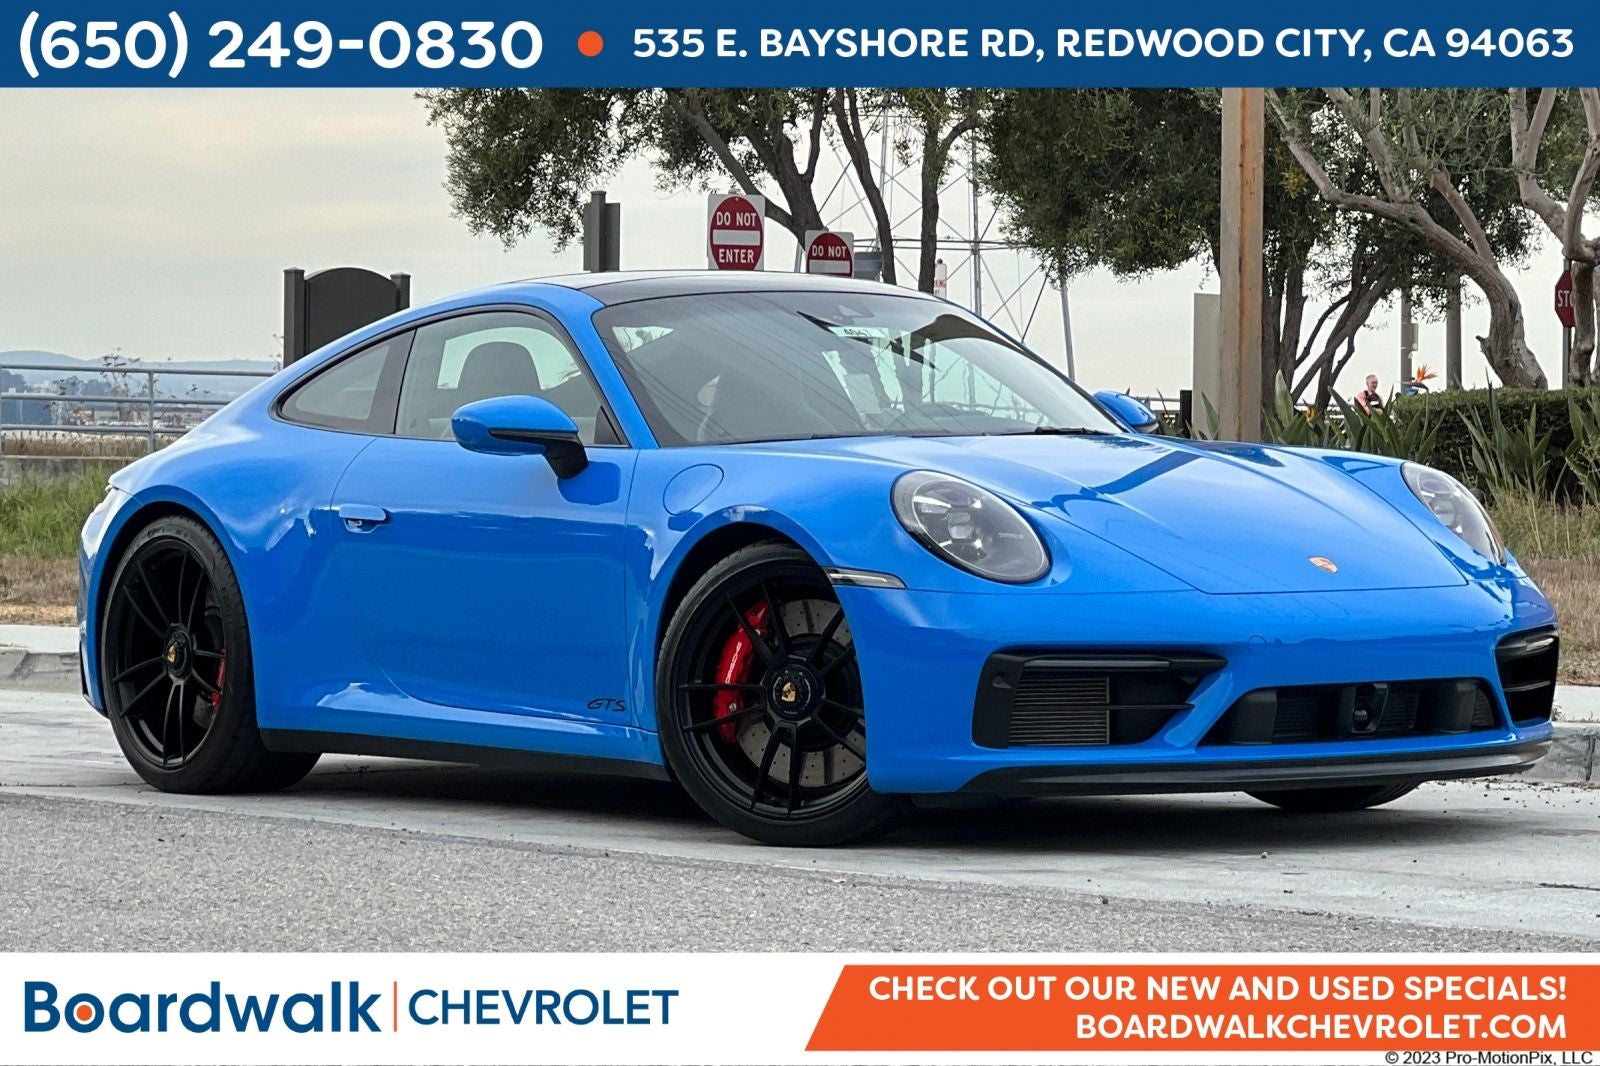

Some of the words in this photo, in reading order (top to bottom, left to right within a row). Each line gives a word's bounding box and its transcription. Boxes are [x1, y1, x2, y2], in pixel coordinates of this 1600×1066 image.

[716, 211, 731, 226] DO
[736, 212, 757, 227] NOT
[718, 248, 755, 264] ENTER
[811, 245, 824, 257] DO
[828, 246, 847, 258] NOT
[1557, 290, 1570, 307] ST
[587, 698, 626, 712] GTS
